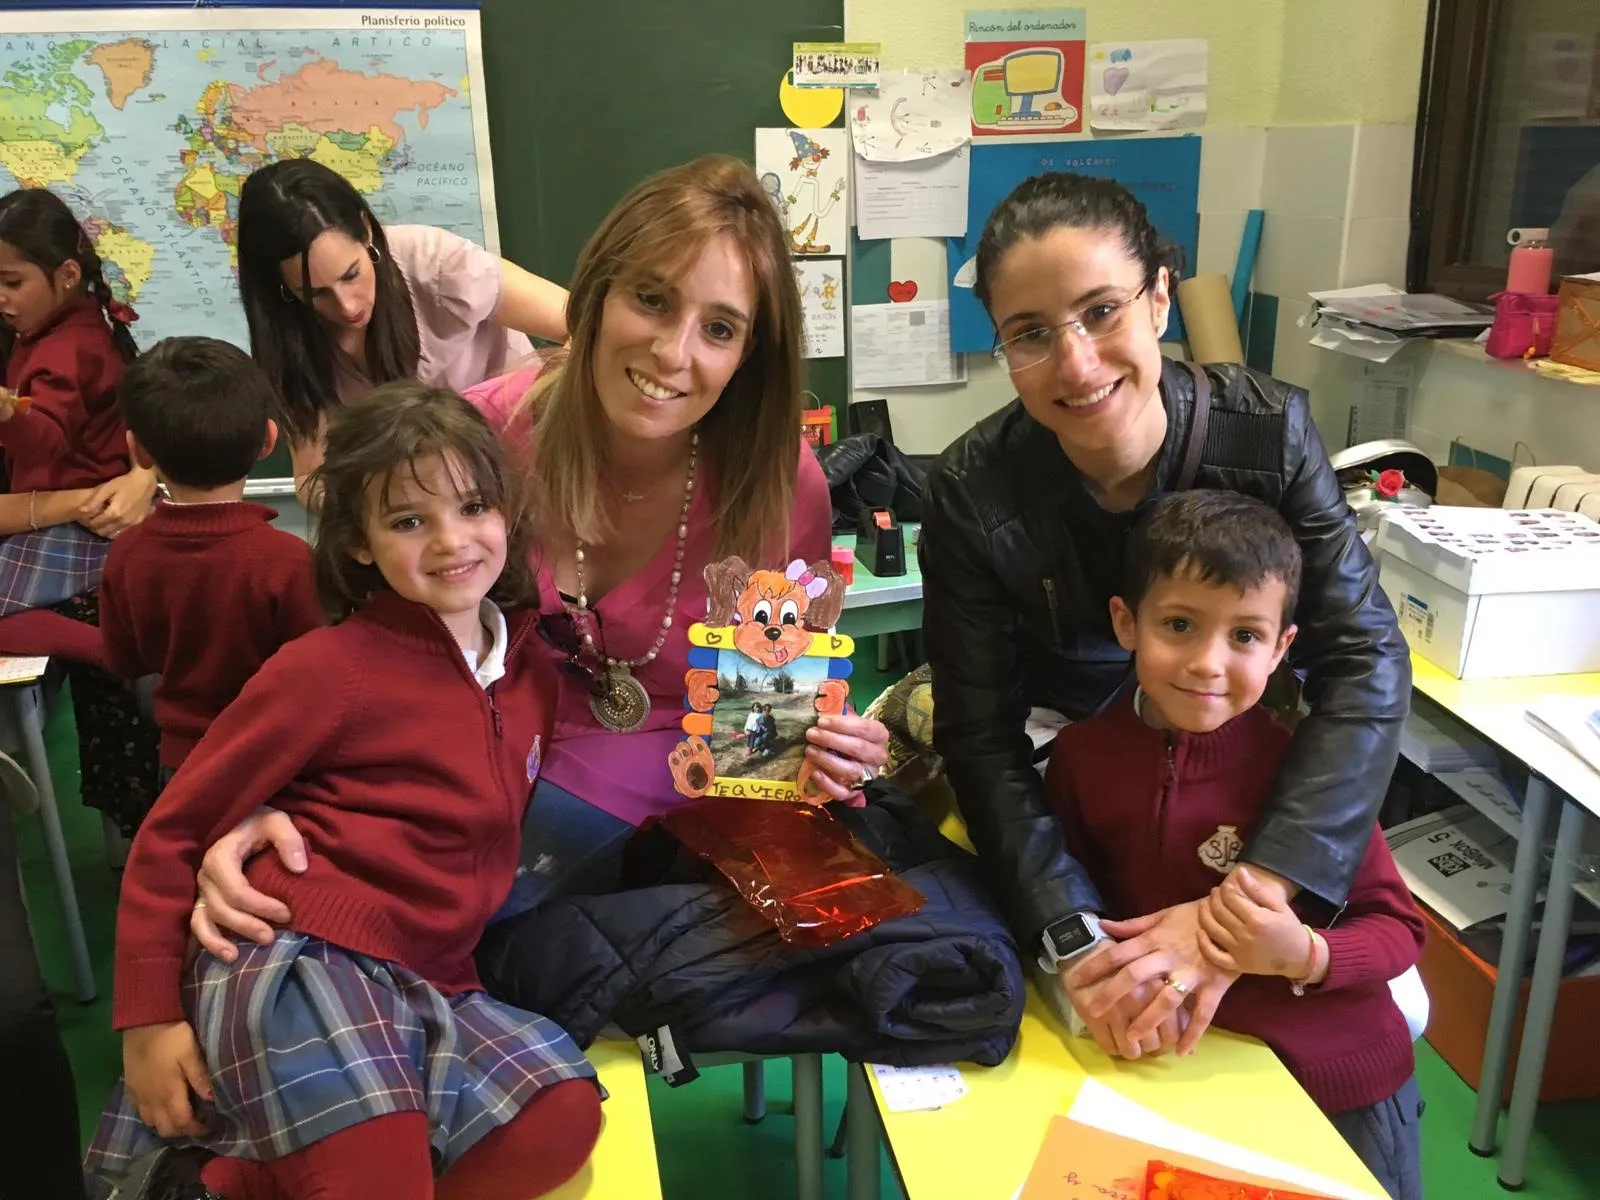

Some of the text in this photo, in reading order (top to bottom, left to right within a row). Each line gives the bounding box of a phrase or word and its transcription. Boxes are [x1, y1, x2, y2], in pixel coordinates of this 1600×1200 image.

[361, 15, 466, 28] Planisferio político
[969, 19, 1076, 32] Rincón del ordenador
[1427, 832, 1450, 844] 5
[648, 1037, 659, 1071] ONLY
